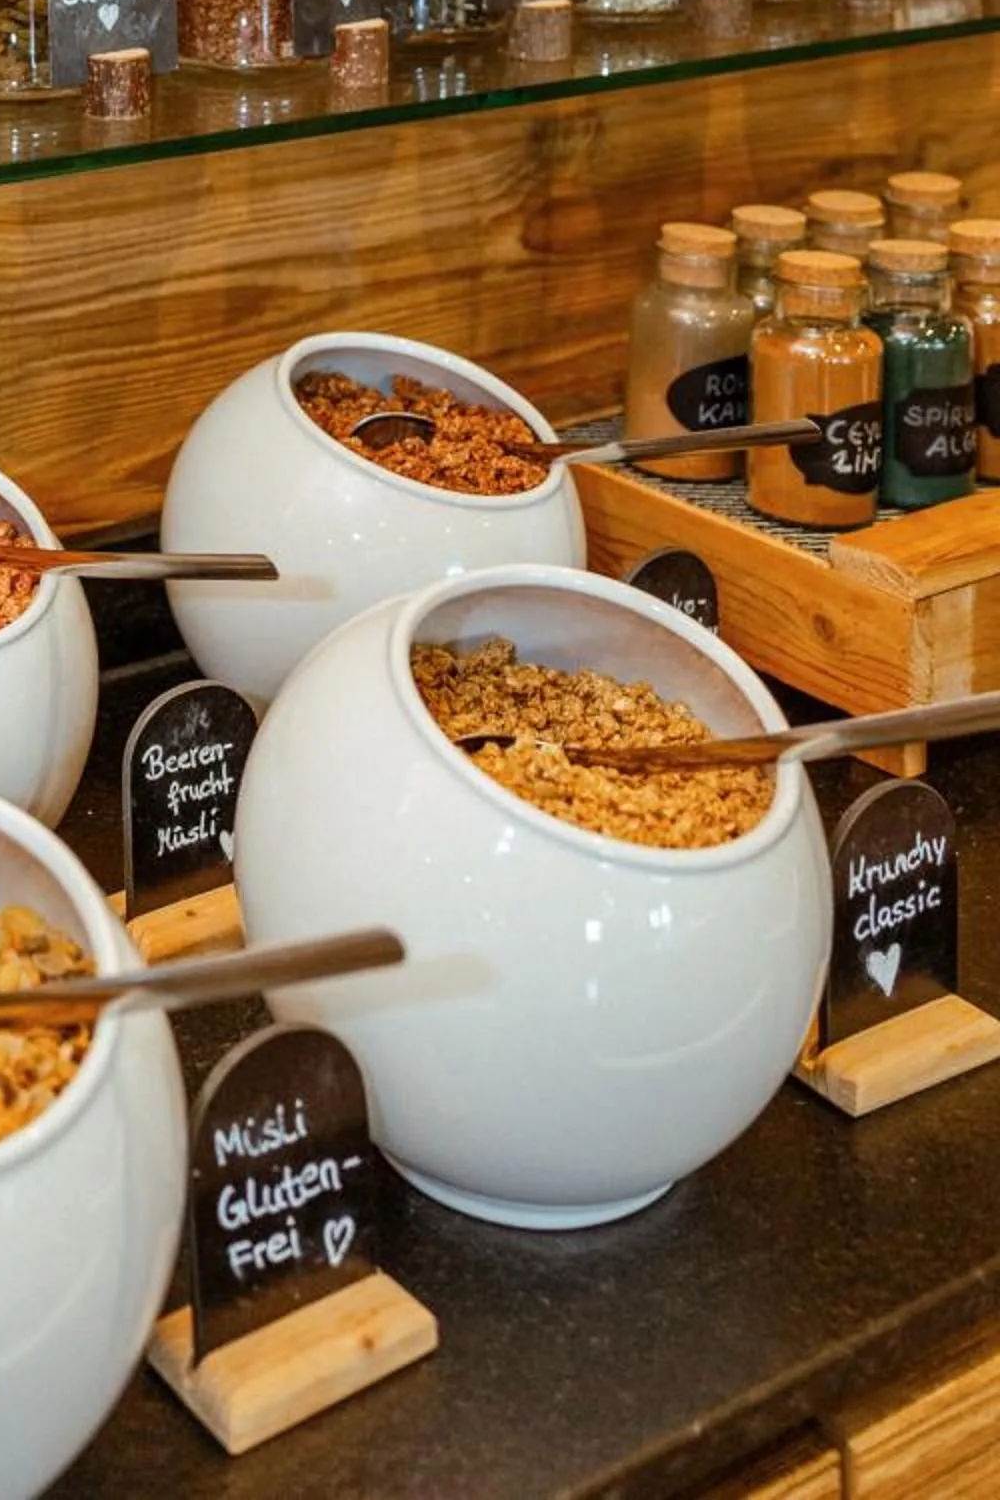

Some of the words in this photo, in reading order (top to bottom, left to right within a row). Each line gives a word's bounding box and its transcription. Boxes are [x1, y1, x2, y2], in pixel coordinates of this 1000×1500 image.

[142, 742, 233, 781] Beeren-
[167, 762, 234, 817] frucht
[848, 831, 946, 899] Krunchy
[853, 879, 942, 941] classic
[217, 1154, 363, 1230] Gluten-
[227, 1214, 303, 1282] Frei
